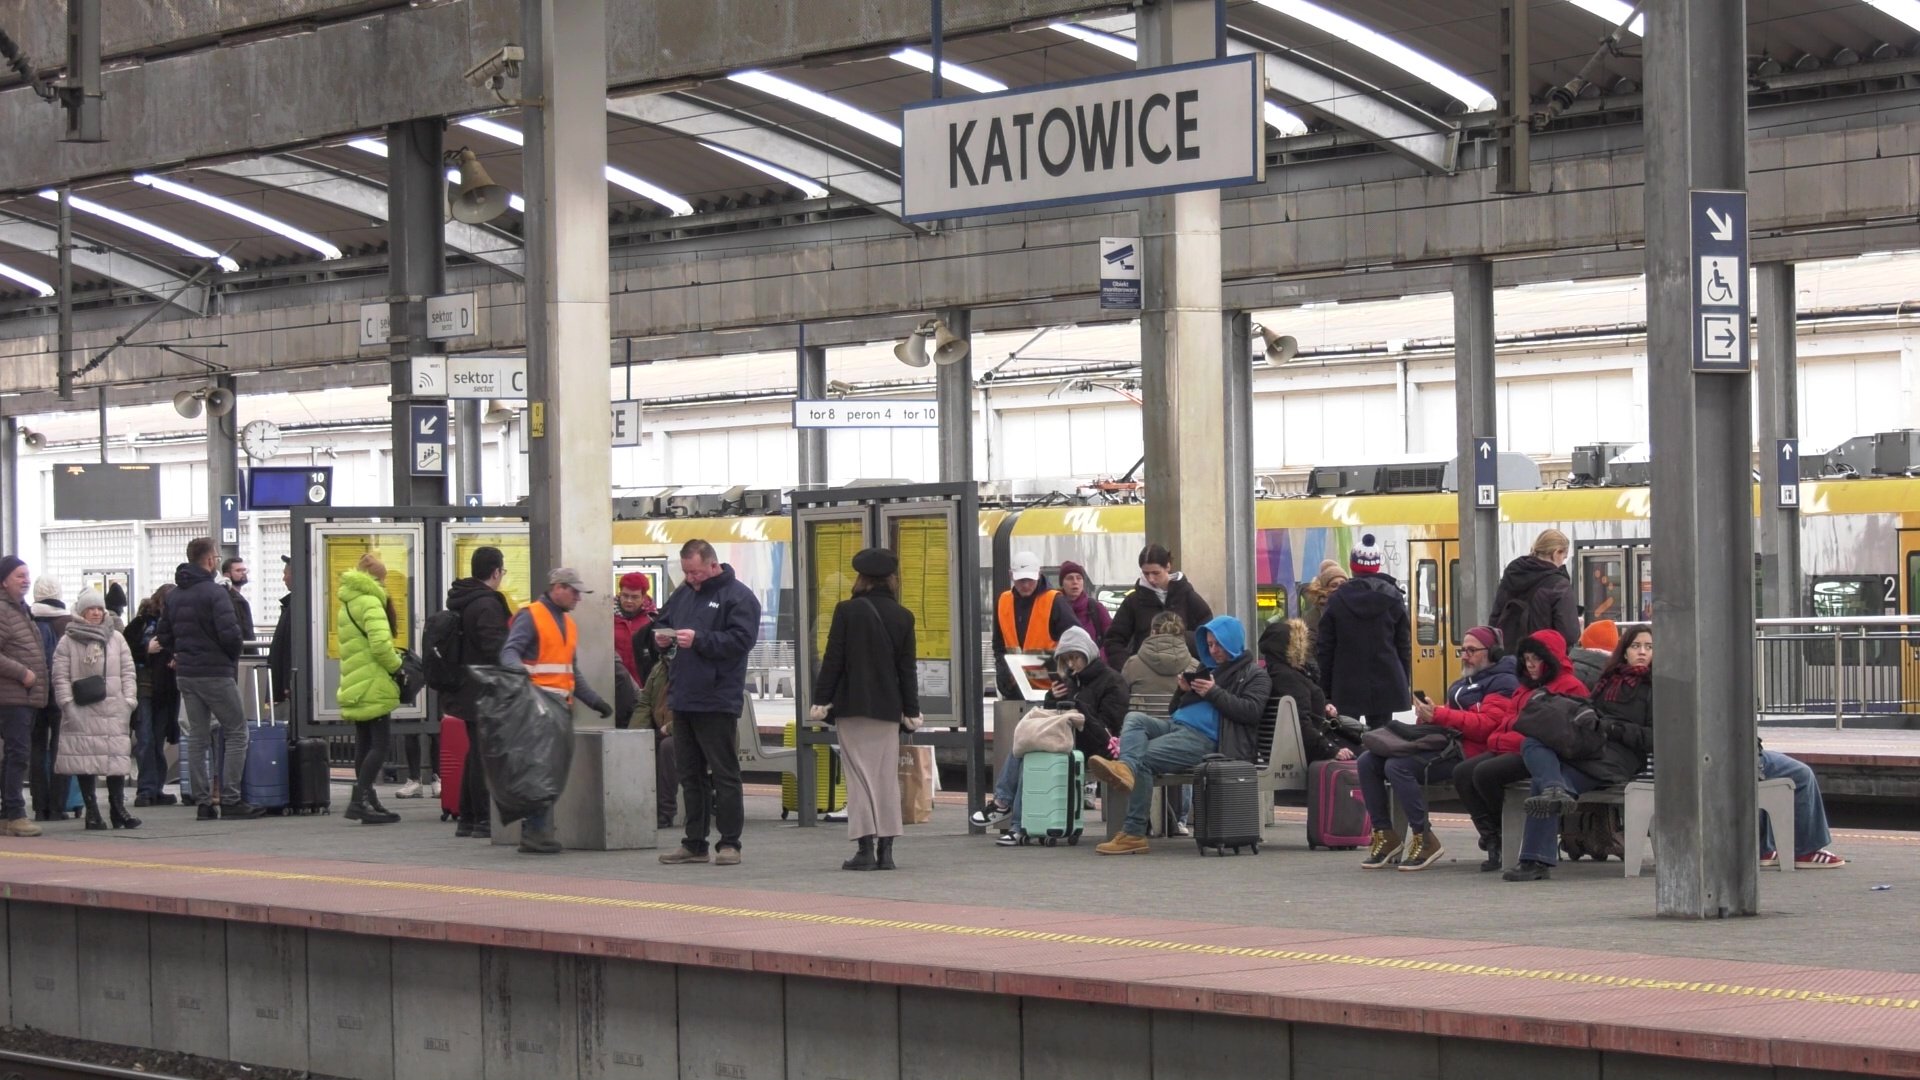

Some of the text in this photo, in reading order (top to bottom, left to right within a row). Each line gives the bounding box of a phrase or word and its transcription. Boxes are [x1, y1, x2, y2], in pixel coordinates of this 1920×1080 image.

[949, 89, 1200, 189] KATOWICE
[432, 307, 469, 328] sektor D
[366, 318, 373, 338] C
[454, 371, 524, 391] sektor C
[611, 410, 625, 438] E
[810, 408, 936, 422] tor 8 peron 4 tor 10
[311, 472, 325, 483] 10
[1884, 576, 1896, 602] 2
